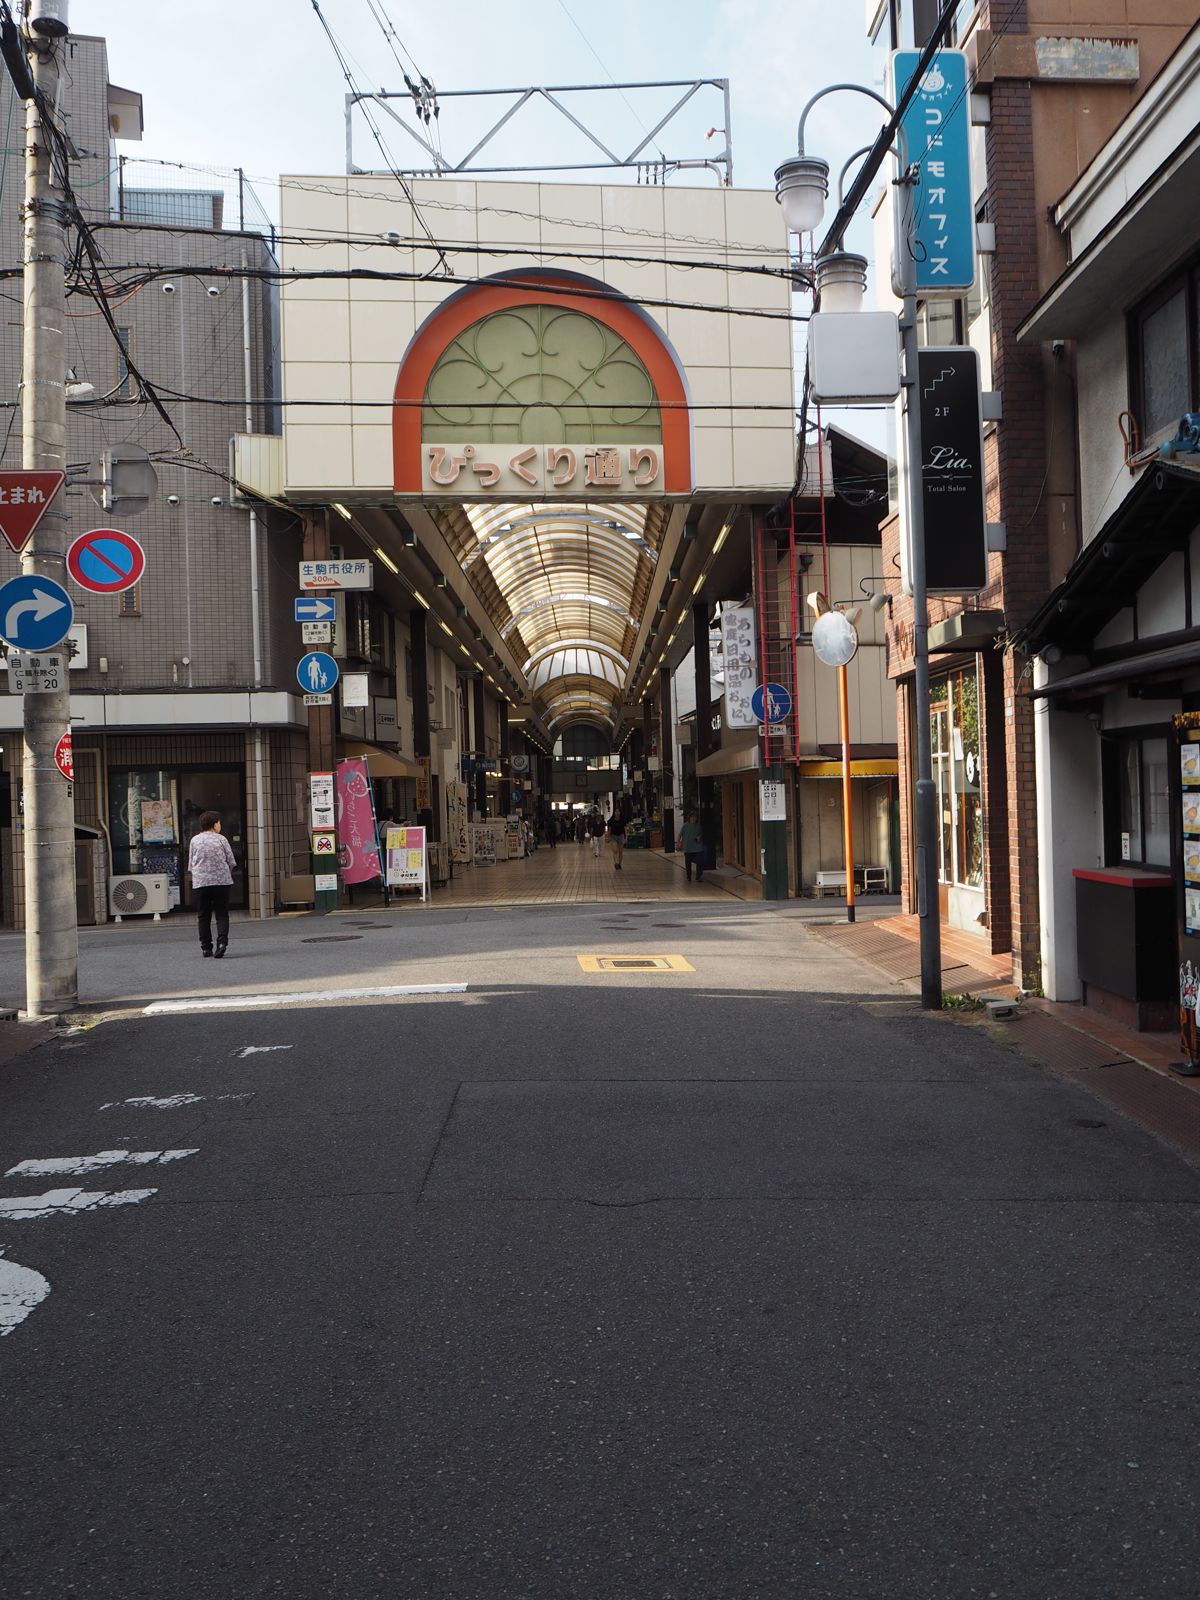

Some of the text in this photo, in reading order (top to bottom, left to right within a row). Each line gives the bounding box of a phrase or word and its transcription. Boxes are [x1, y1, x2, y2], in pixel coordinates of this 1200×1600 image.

[925, 109, 949, 275] コドモオフィス
[934, 407, 950, 417] 2F
[922, 445, 972, 470] Lia
[428, 444, 660, 488] ぴっくり通り
[947, 484, 967, 492] Salon
[303, 562, 366, 576] 生駒市役所
[11, 657, 60, 669] 自動車
